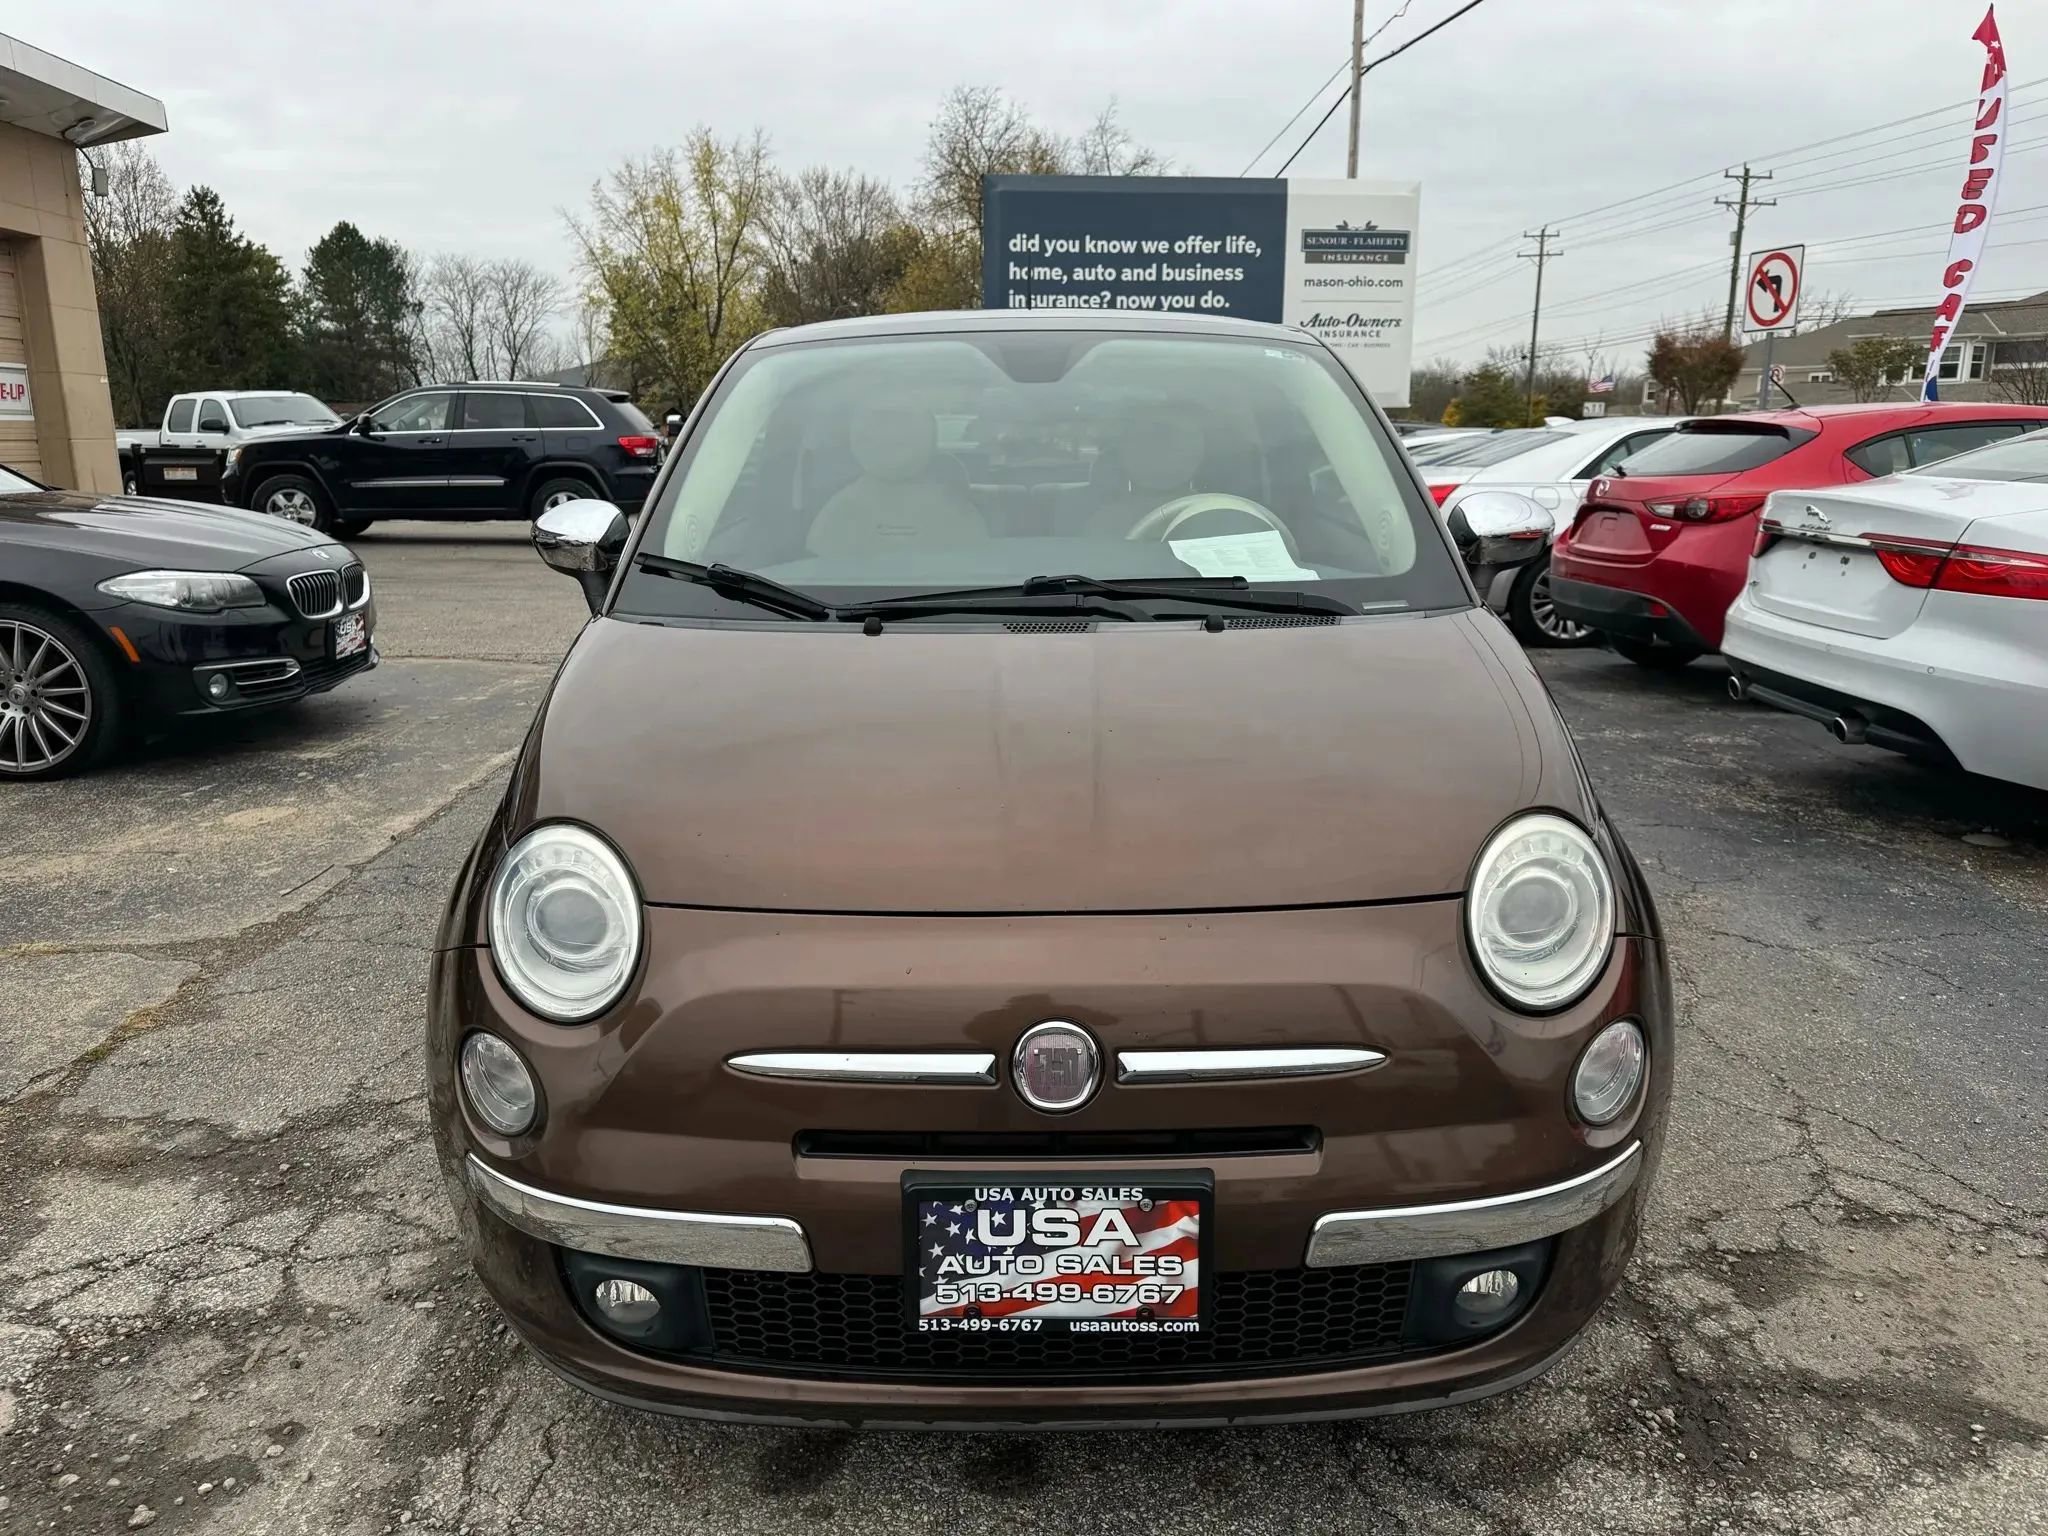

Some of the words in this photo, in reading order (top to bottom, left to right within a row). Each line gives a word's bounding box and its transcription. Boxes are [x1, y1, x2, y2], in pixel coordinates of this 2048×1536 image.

[1008, 233, 1040, 252] did
[1044, 239, 1080, 257] you
[1085, 235, 1138, 254] know
[1141, 241, 1169, 254] we
[1173, 235, 1221, 255] offer
[1225, 235, 1262, 258] life,
[1322, 253, 1390, 262] INSURANCE
[1008, 261, 1068, 285] home,
[1072, 264, 1117, 281] auto
[1121, 264, 1159, 282] and
[1162, 264, 1244, 282] business
[1304, 276, 1403, 288] mason-ohio.com
[1008, 289, 1112, 309] insurance?
[1116, 293, 1157, 309] now
[1160, 293, 1196, 310] you
[1200, 291, 1230, 309] do.
[1300, 313, 1403, 328] Auto-Owners
[1319, 329, 1382, 338] INSURANCE
[974, 1188, 1015, 1201] USA
[1020, 1187, 1075, 1201] AUTO
[1081, 1187, 1143, 1201] SALES
[975, 1208, 1141, 1248] USA
[936, 1254, 1045, 1276] AUTO
[1057, 1254, 1184, 1276] SALES
[935, 1282, 1185, 1305] 513-499-6767
[918, 1319, 1043, 1332] 513-499-6767
[1069, 1319, 1200, 1333] usaautoss.com
